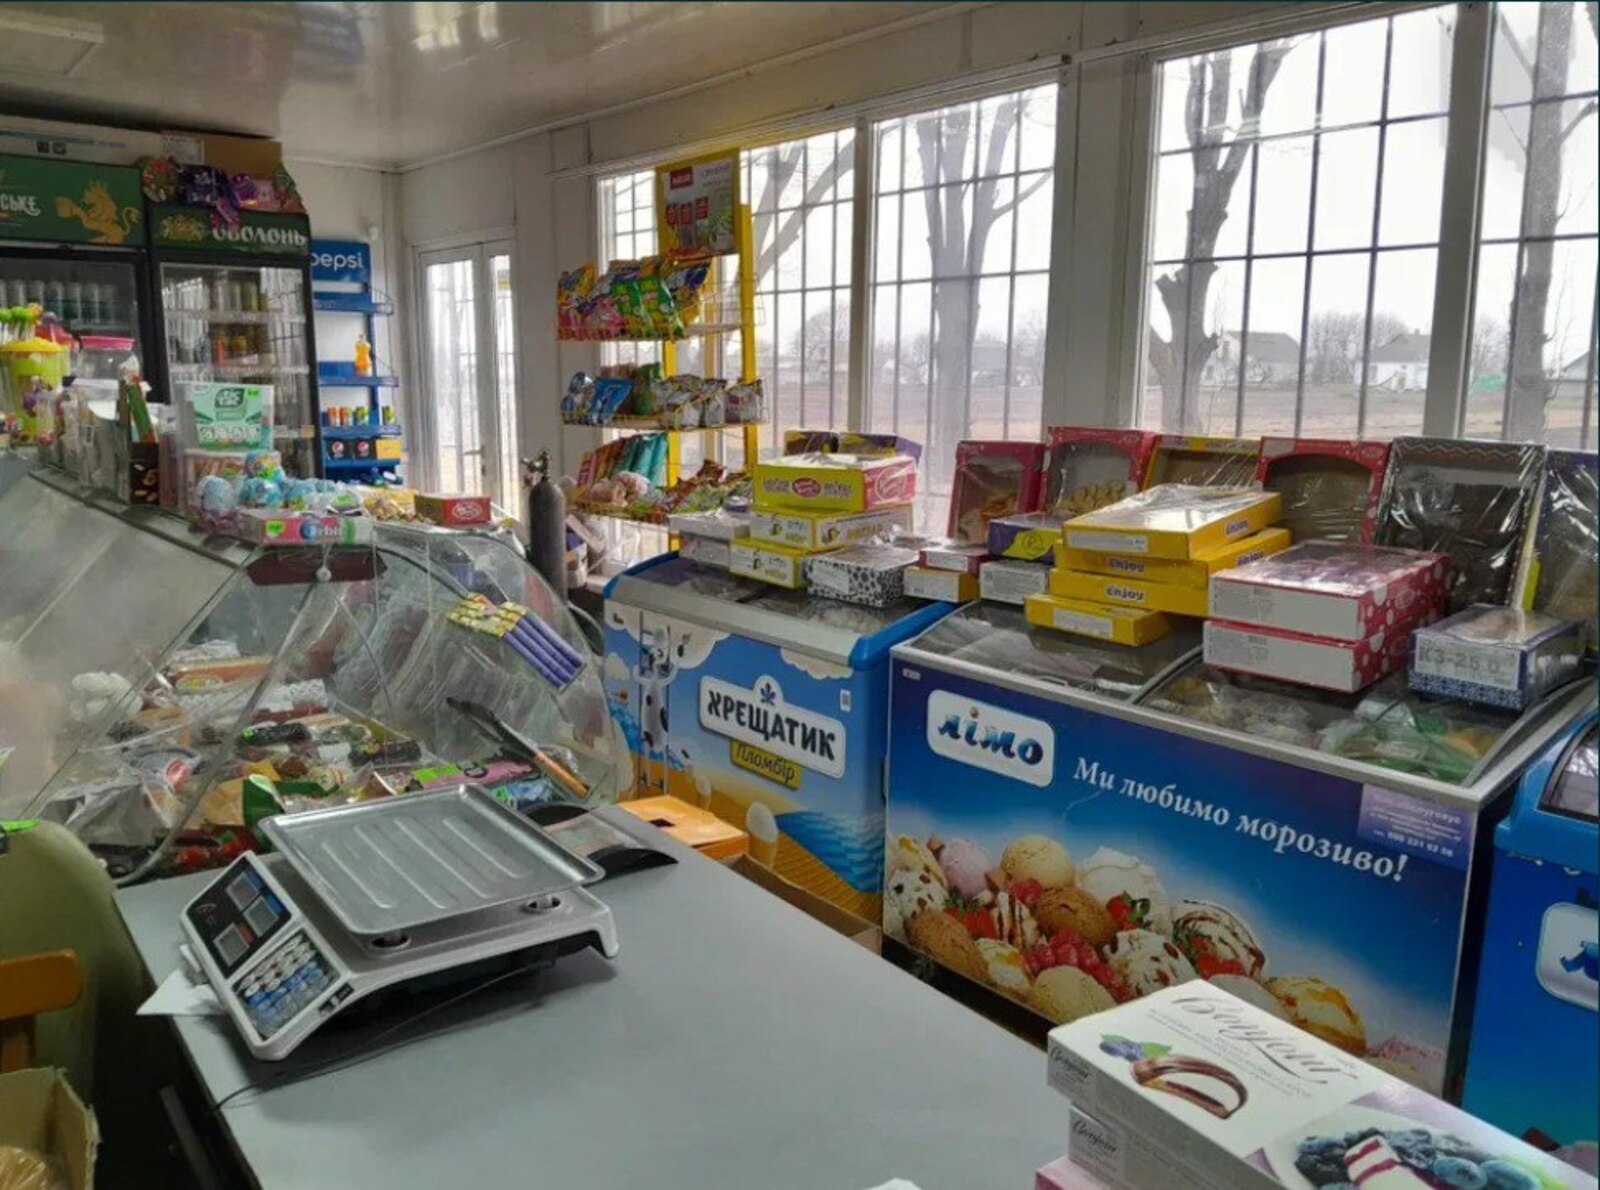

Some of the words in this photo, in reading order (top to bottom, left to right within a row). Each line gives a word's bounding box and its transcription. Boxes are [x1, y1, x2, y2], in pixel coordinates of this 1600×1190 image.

[707, 690, 836, 761] ХРЕЩАТИК
[737, 743, 796, 785] Пломбір
[1073, 757, 1116, 790] Ми
[1119, 780, 1231, 826] любимо
[1234, 814, 1409, 883] морозиво!
